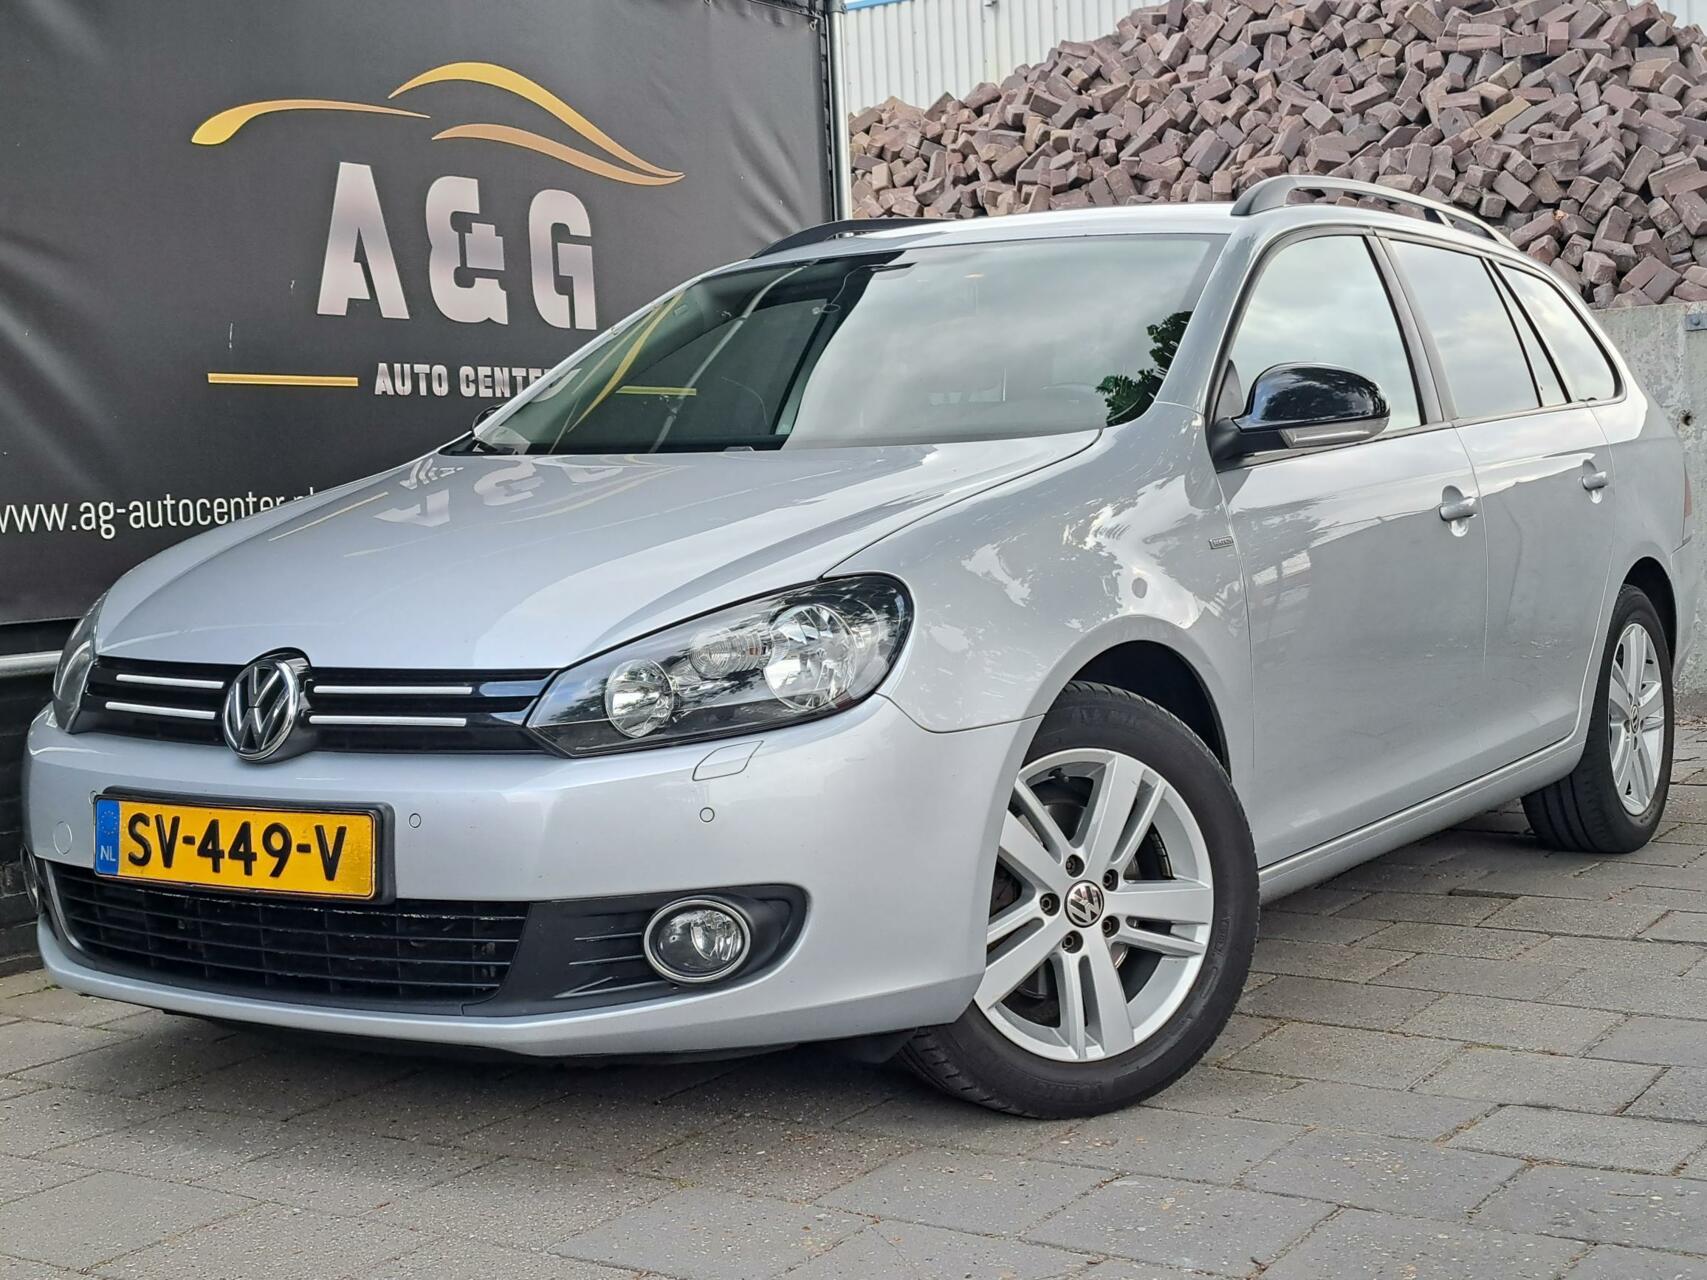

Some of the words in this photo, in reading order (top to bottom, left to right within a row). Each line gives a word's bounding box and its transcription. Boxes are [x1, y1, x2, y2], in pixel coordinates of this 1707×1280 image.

[317, 161, 597, 330] A&G
[374, 362, 448, 397] AUTO
[459, 365, 552, 398] CENT
[99, 844, 117, 862] NL
[127, 812, 347, 881] SV-449-V
